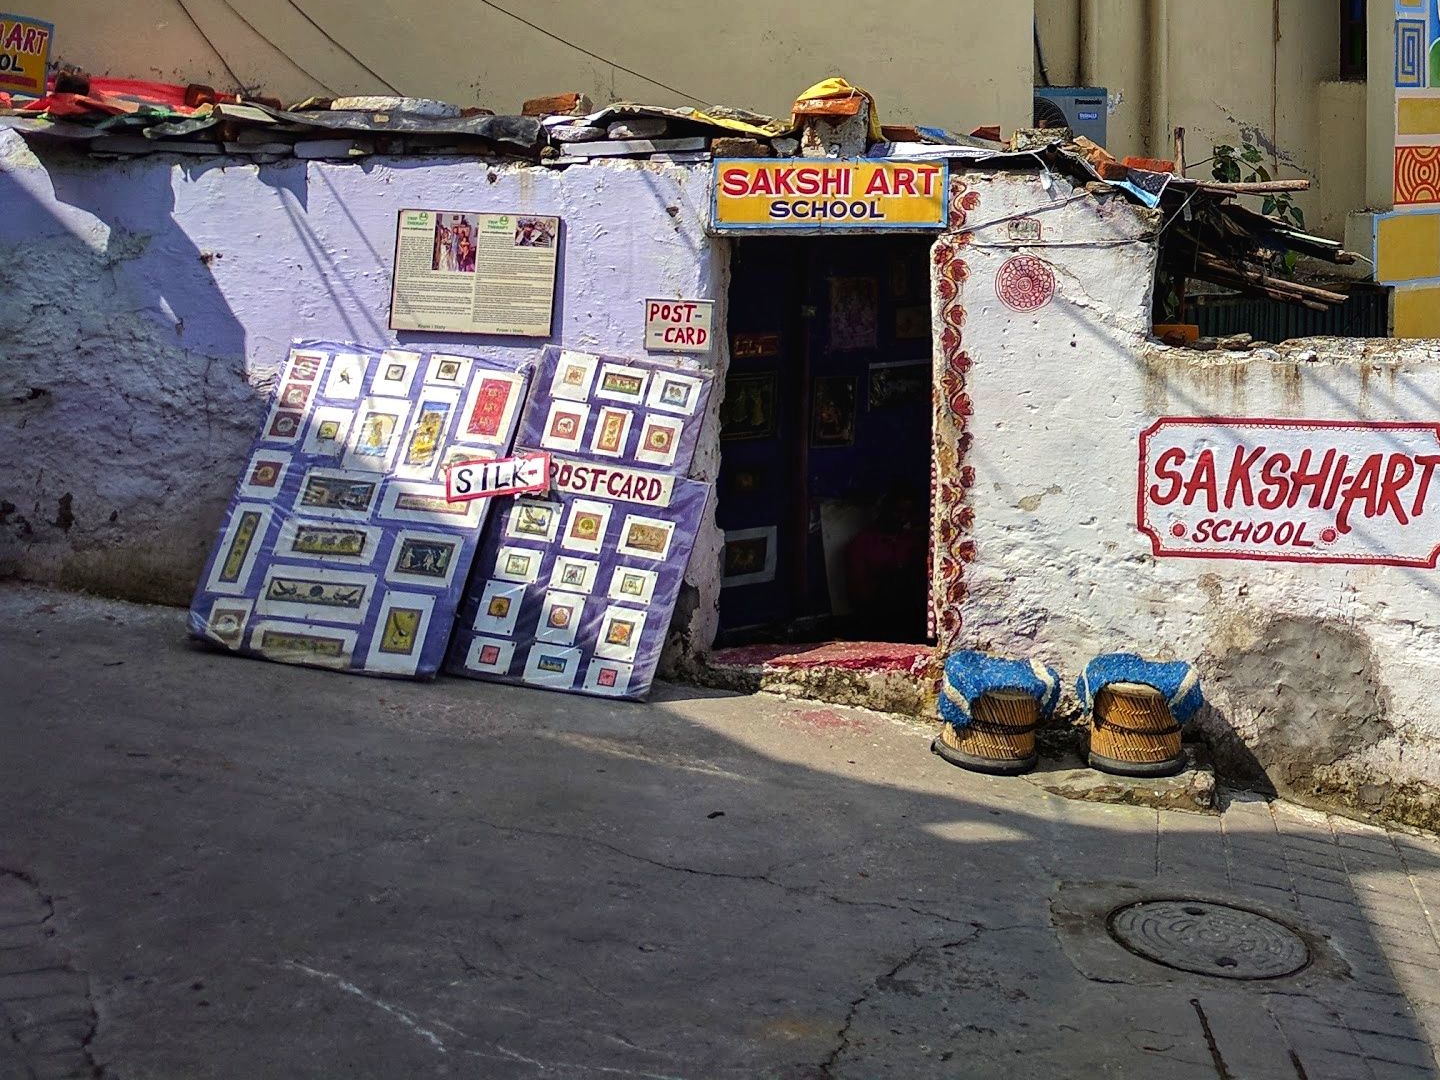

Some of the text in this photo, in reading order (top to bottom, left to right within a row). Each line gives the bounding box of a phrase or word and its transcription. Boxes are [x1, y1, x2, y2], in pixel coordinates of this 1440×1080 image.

[5, 23, 48, 54] ART
[722, 168, 939, 196] SAKSHI ART
[769, 200, 884, 218] SCHOOL
[650, 303, 702, 323] POST-
[1192, 519, 1314, 547] SCHOOL
